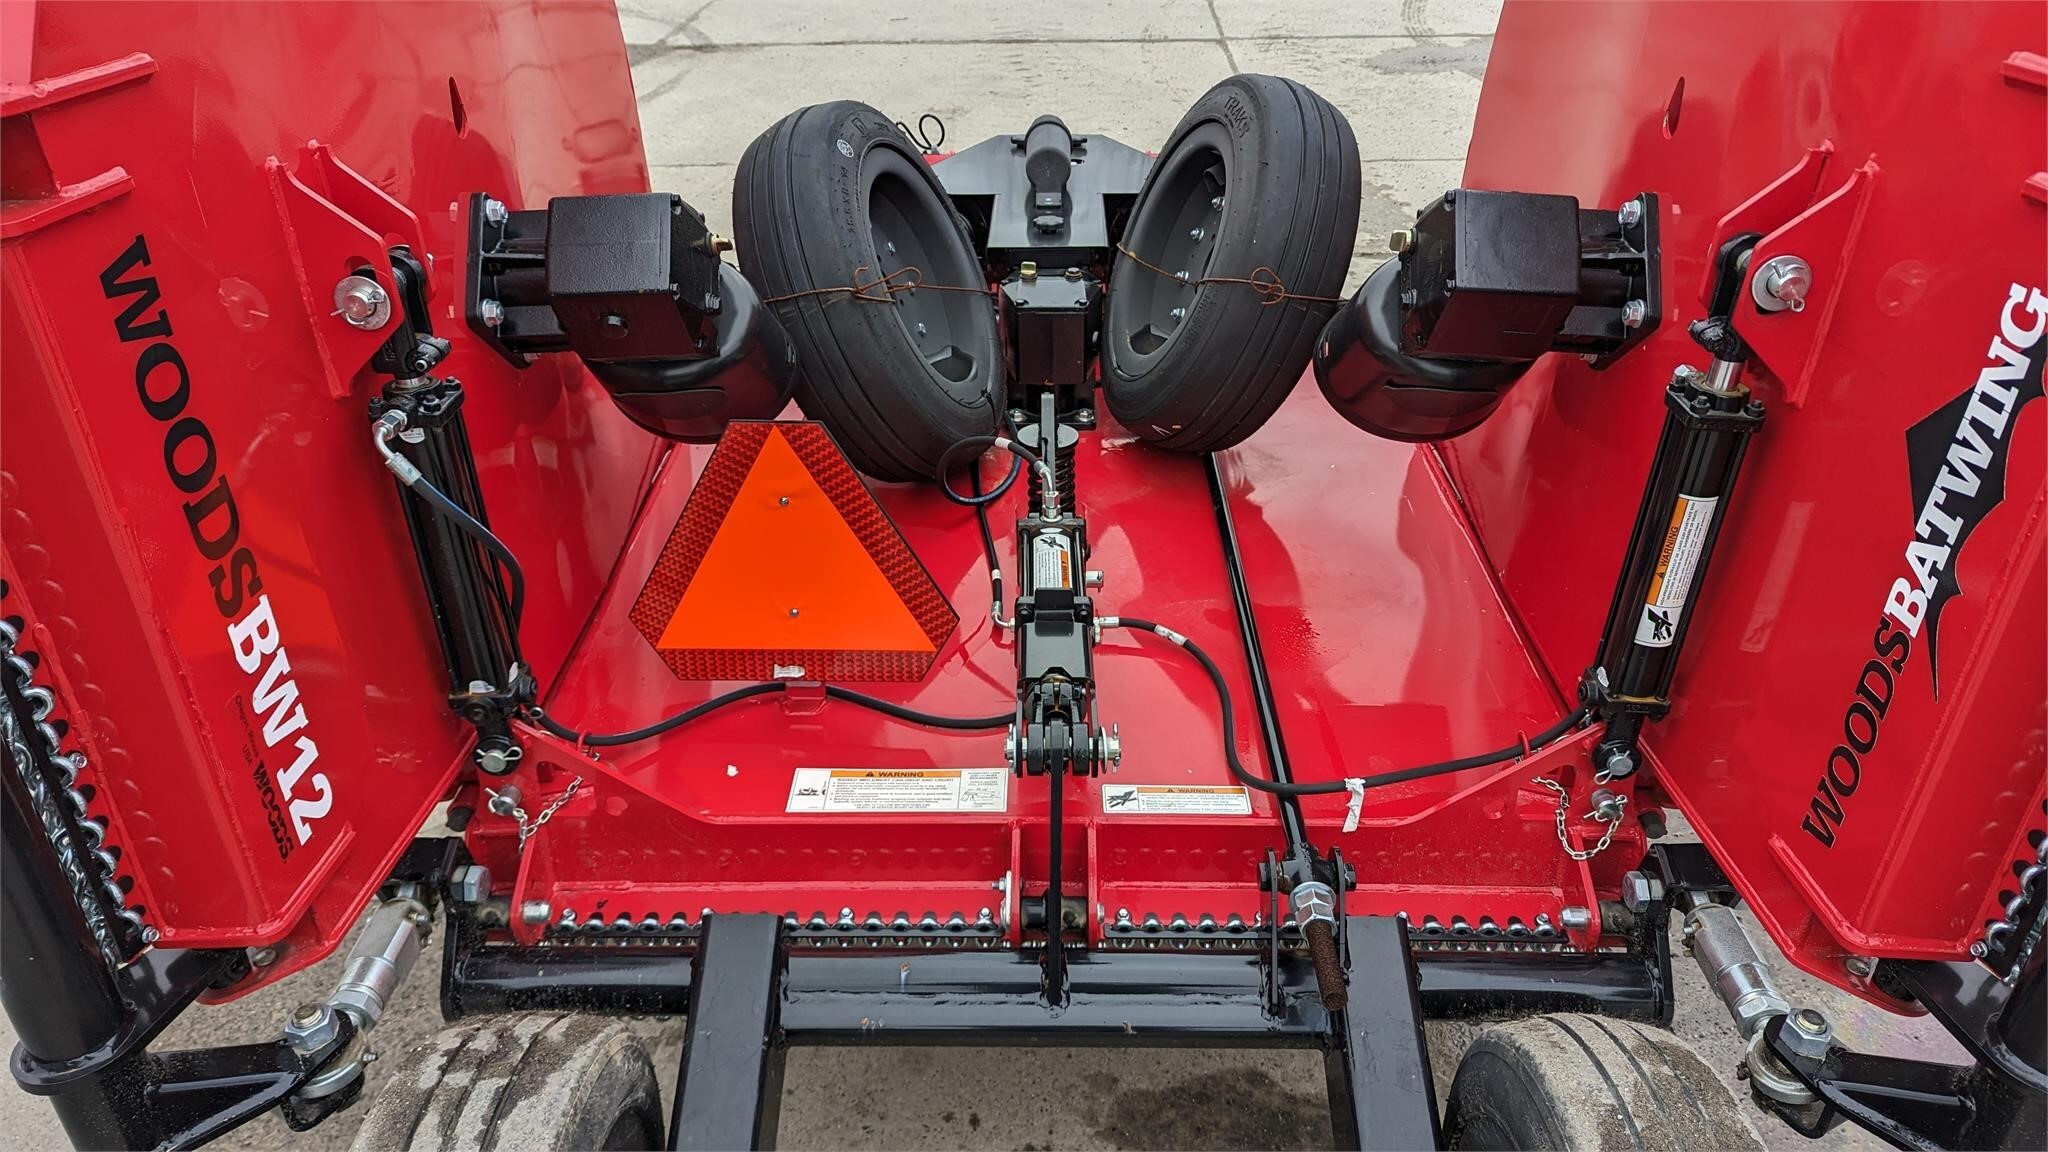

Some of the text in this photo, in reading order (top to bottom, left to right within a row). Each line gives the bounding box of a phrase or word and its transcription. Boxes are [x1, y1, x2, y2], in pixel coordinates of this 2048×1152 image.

[99, 233, 333, 846] WOODS BW12
[1659, 526, 1679, 567] WARNING
[1800, 282, 2048, 848] WOODS BATWING
[253, 759, 294, 860] WOODS
